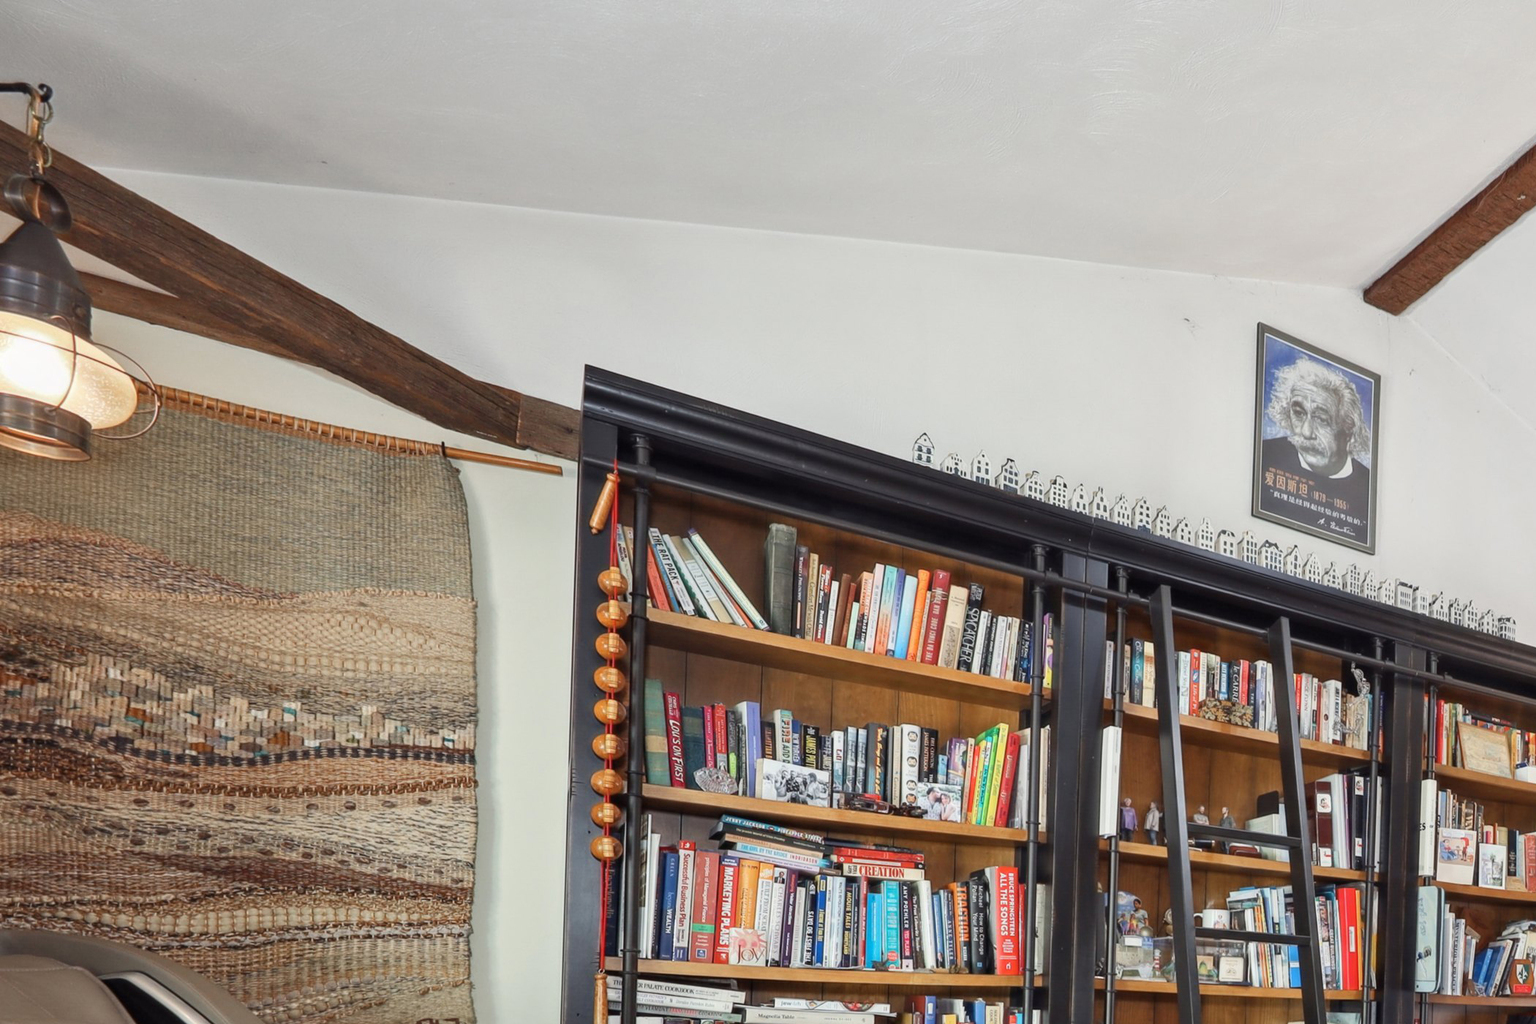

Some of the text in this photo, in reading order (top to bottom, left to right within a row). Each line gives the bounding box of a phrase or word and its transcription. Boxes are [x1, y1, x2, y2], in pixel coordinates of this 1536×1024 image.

[1265, 471, 1308, 498] 爱因斯坦
[652, 535, 678, 581] THE RAT PACK
[928, 630, 937, 643] VINCI
[960, 608, 980, 662] SPYCATCHER
[669, 720, 684, 782] LOU'S ON FIRST
[782, 719, 791, 759] FIRE AND
[806, 735, 816, 754] JAMES
[725, 816, 742, 826] JENNY
[742, 820, 765, 829] JACKSON
[682, 853, 690, 885] Successful
[859, 865, 905, 879] CREATION
[679, 886, 688, 912] Business
[720, 867, 733, 945] MARKETING PLANS
[665, 909, 673, 934] WEALTH
[957, 887, 969, 942] TRACTION
[1000, 907, 1008, 936] SONGS
[804, 951, 812, 963] THE
